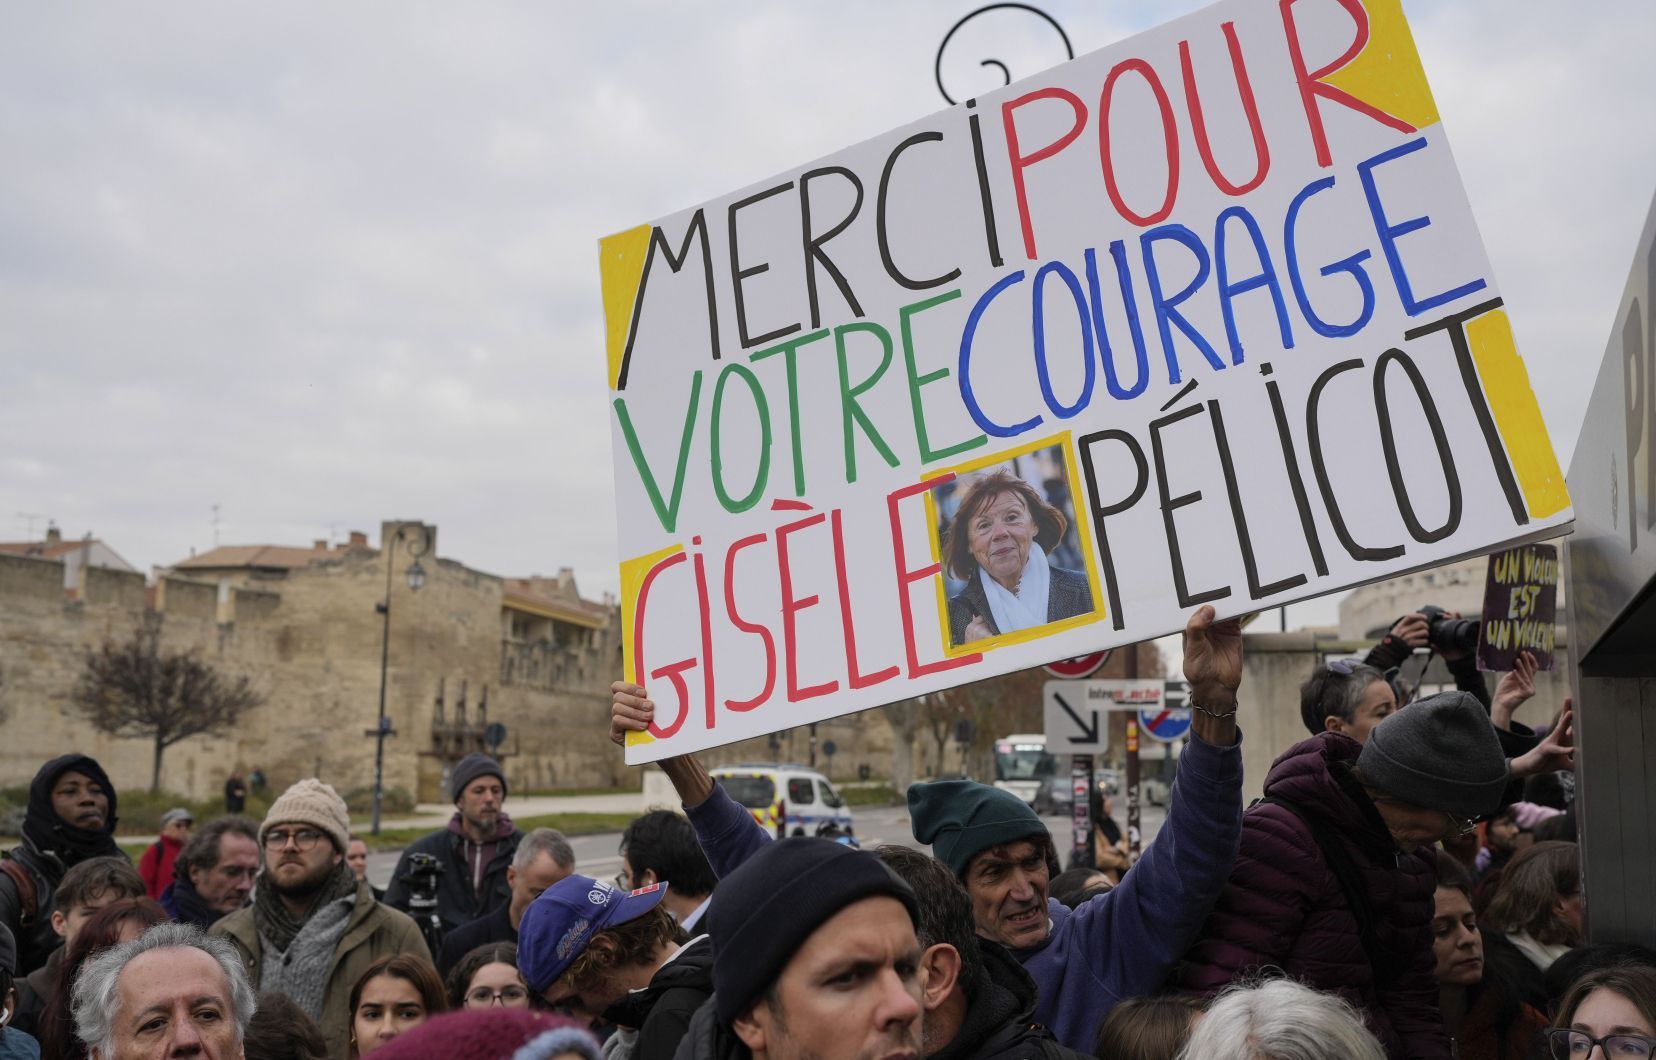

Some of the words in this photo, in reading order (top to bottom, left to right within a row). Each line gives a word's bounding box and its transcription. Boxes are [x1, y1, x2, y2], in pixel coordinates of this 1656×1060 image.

[617, 100, 1004, 391] MERCI
[1001, 0, 1417, 260] POUR
[614, 289, 988, 534] VOTRE
[957, 137, 1488, 438] COURAGE
[633, 472, 984, 740] GISÈLE
[1077, 297, 1529, 632] PÉLICOT
[1494, 549, 1520, 584] UN
[1524, 547, 1558, 585] VIOLEU
[1508, 585, 1541, 619] EST
[1487, 619, 1511, 650] UN
